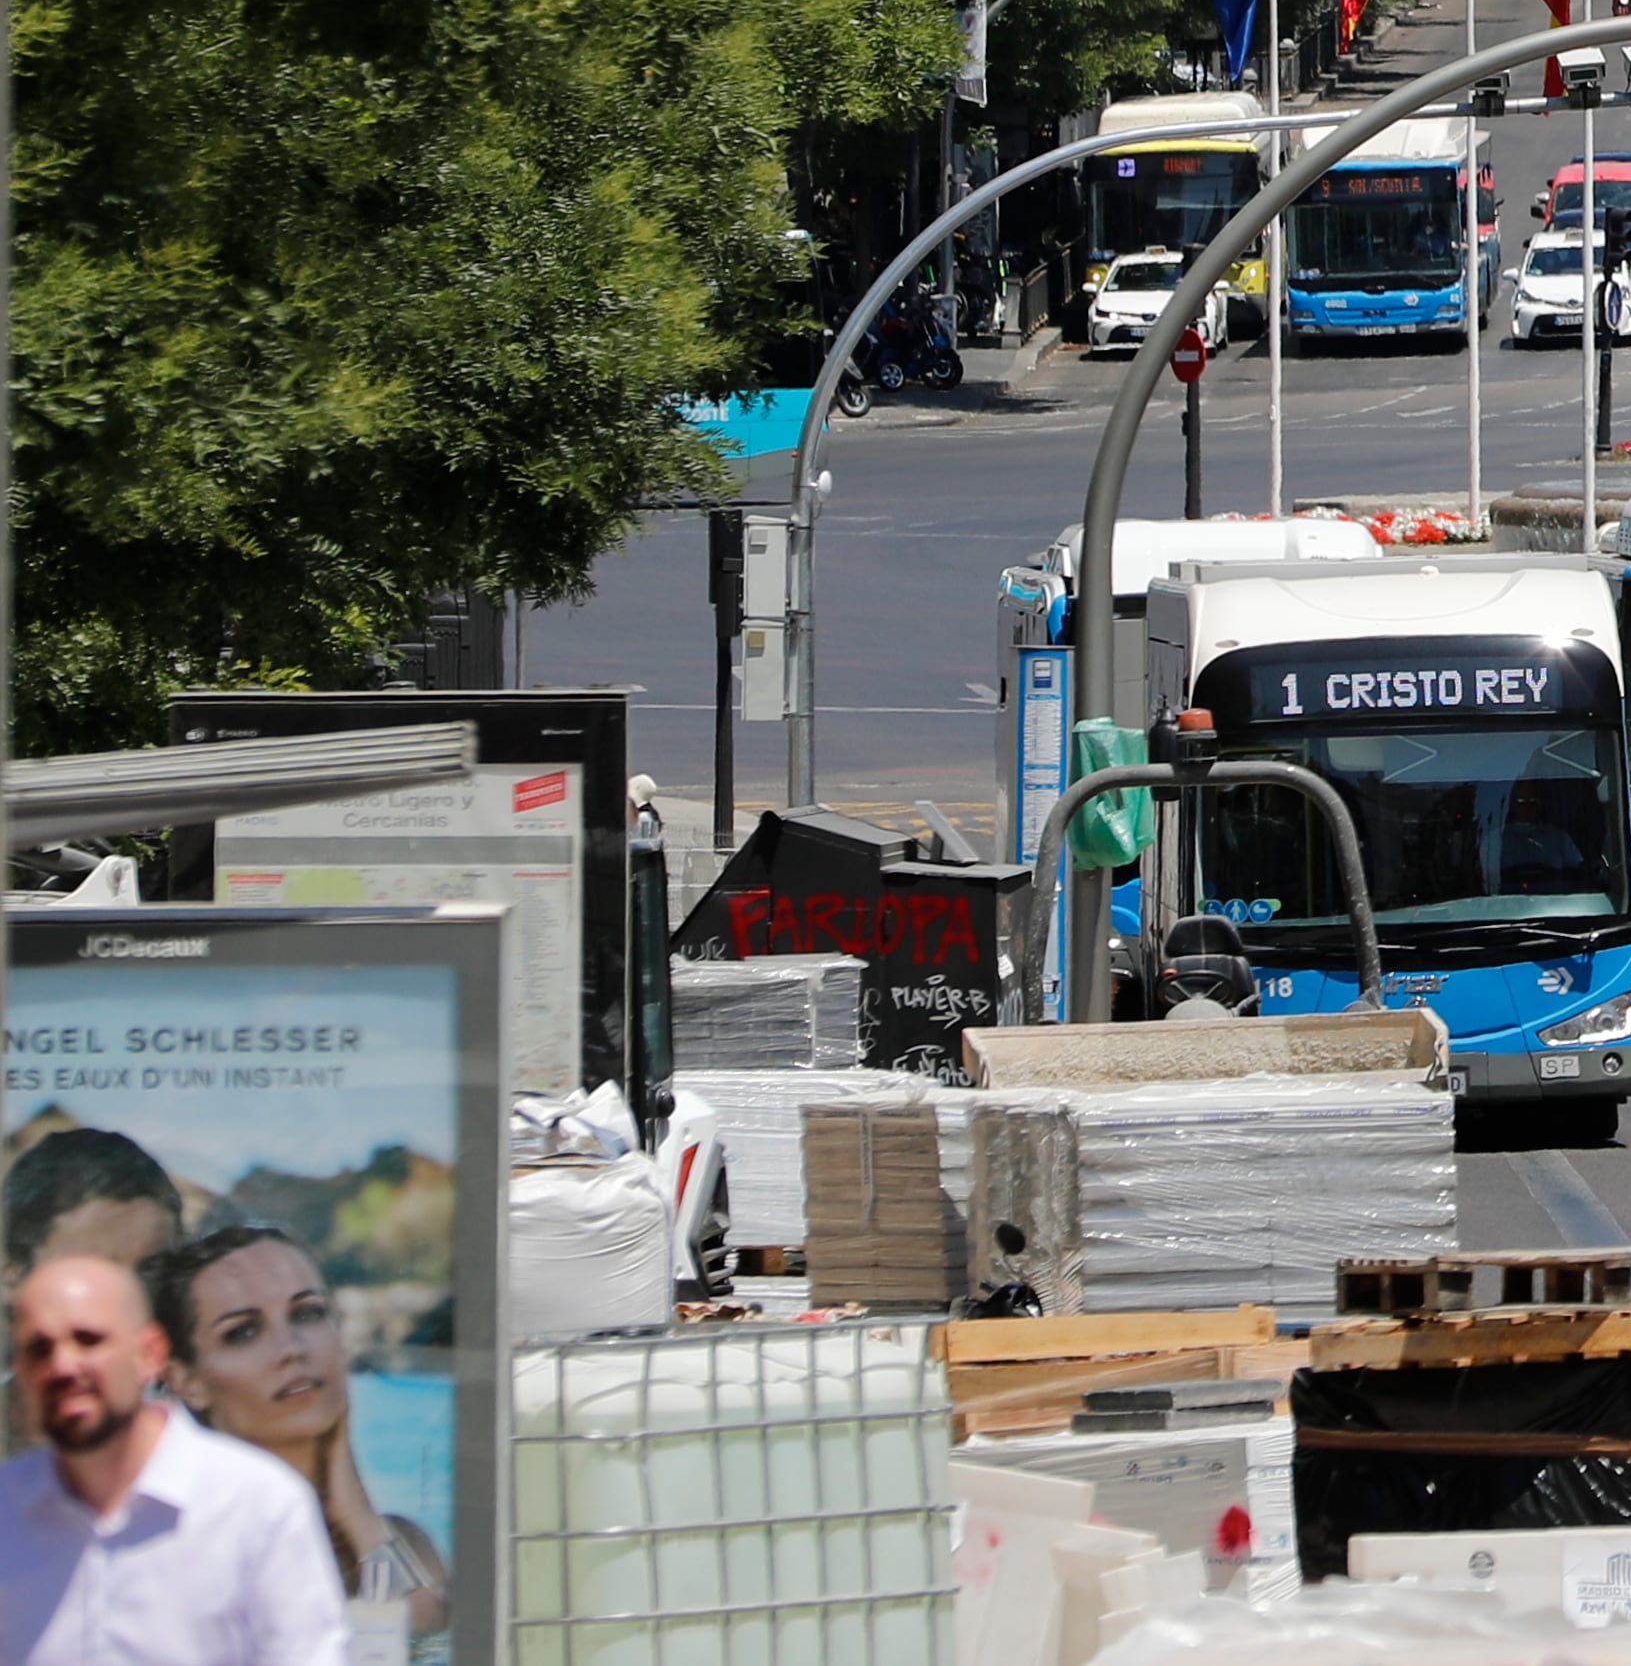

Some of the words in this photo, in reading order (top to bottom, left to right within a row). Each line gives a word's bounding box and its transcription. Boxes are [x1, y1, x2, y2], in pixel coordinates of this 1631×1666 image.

[1282, 673, 1304, 715] 1
[1327, 670, 1462, 709] CRISTO
[1475, 667, 1548, 705] REY
[389, 793, 455, 813] Ligero
[460, 795, 475, 812] y
[343, 811, 449, 830] Cercanías
[727, 884, 981, 967] FARLOPA
[78, 935, 210, 958] JCDecaux
[3, 1028, 105, 1053] NGEL
[125, 1028, 362, 1053] SCHLESSER
[1545, 1058, 1576, 1075] SP
[6, 1069, 41, 1090] ES
[55, 1069, 130, 1090] EAUX
[223, 1068, 344, 1089] INSTANT
